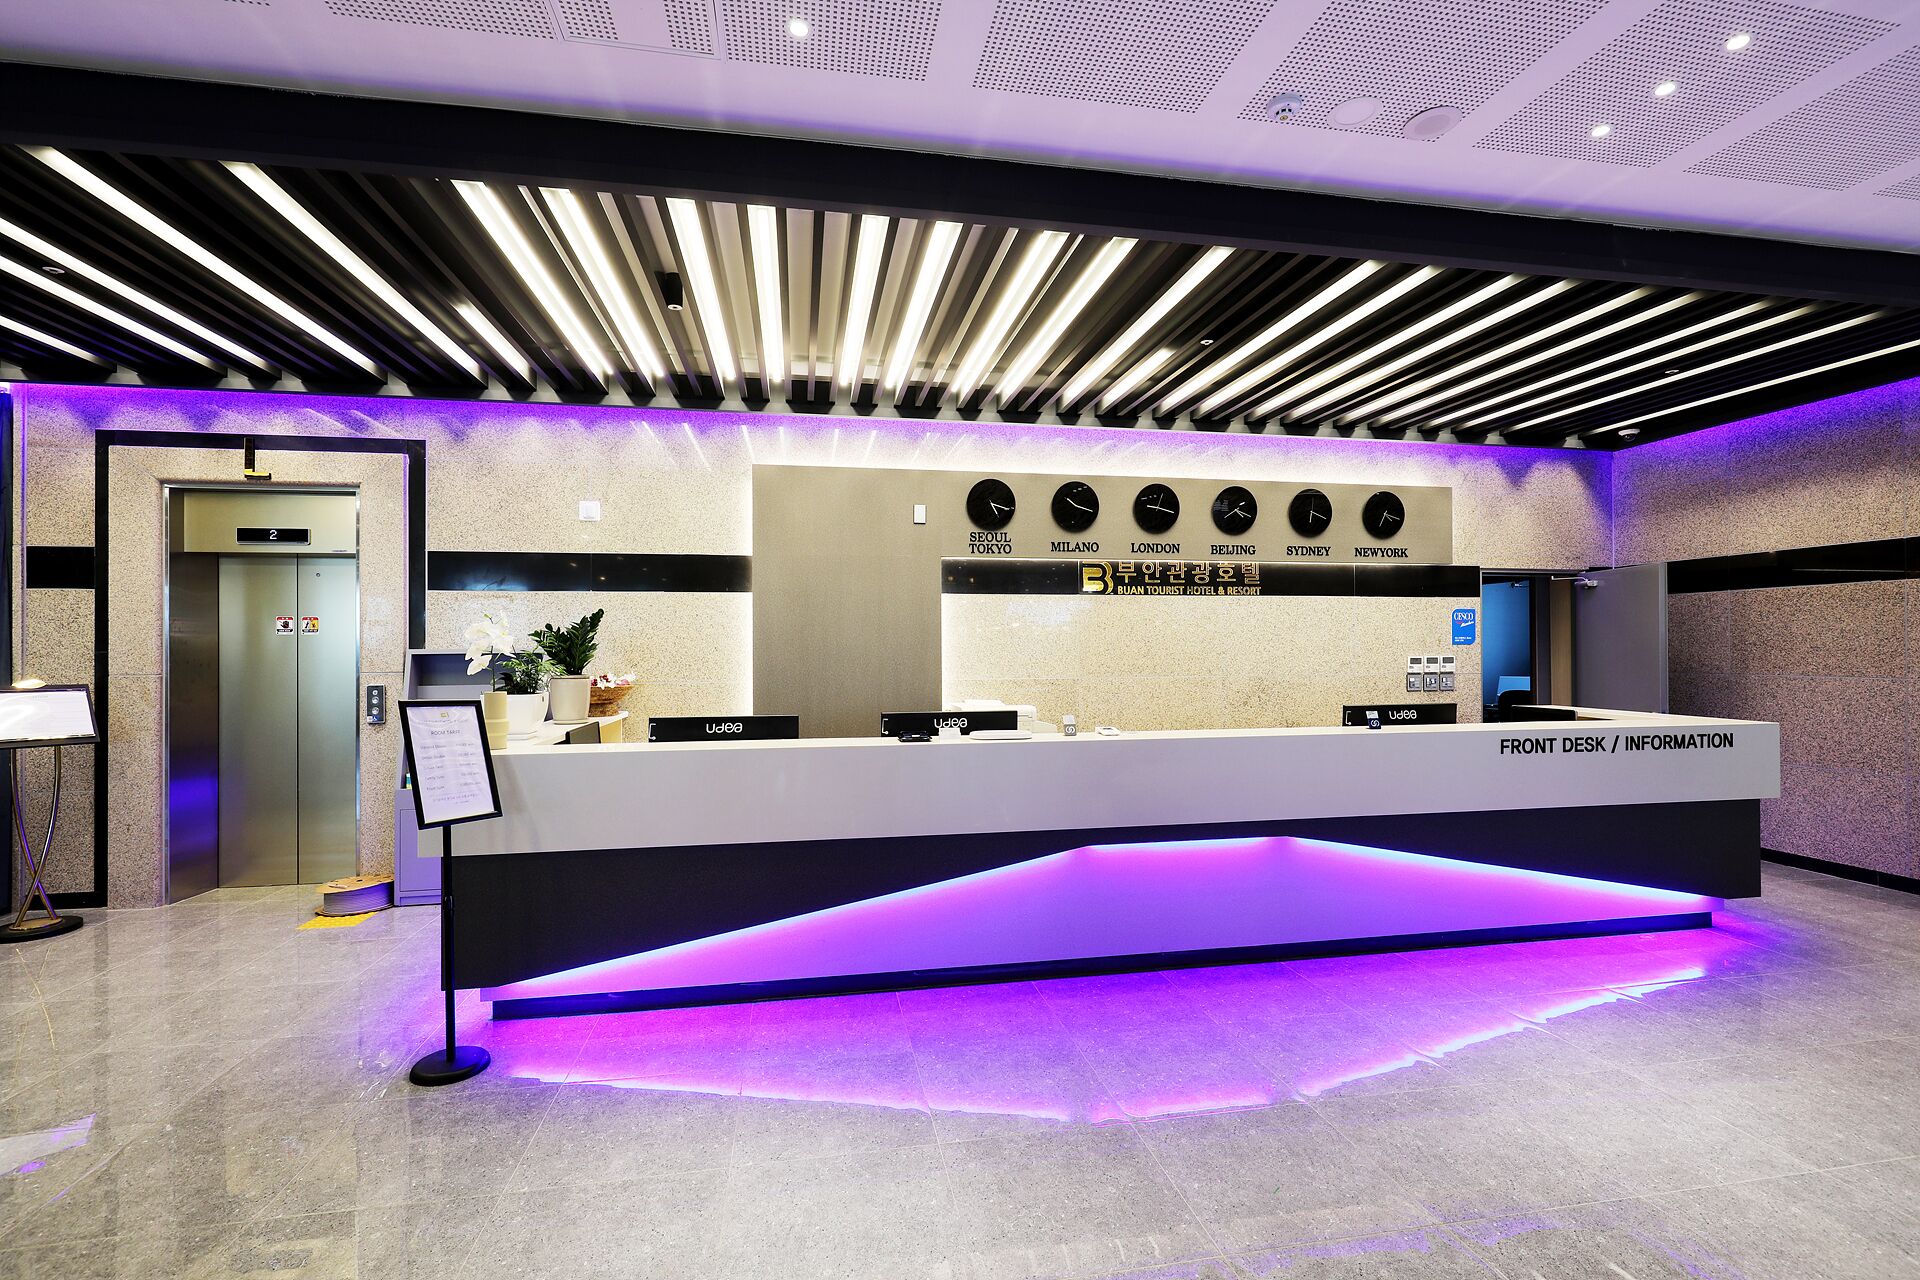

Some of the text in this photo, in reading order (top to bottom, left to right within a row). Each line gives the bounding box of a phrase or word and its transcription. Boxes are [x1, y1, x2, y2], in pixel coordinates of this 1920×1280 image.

[269, 529, 278, 540] 2
[969, 532, 1012, 543] SEOUL
[968, 543, 1012, 554] TOKYO
[1050, 541, 1100, 553] MILANO
[1131, 542, 1180, 554] LONDON
[1210, 544, 1257, 555] BEIJING
[1286, 545, 1331, 556] SYDNEY
[1354, 547, 1408, 558] NEWYORK
[1116, 561, 1261, 585] 부안관광호텔
[1117, 585, 1262, 595] BUAN TOURIST HOTEL & RESORT
[1388, 709, 1417, 720] udea
[706, 722, 743, 734] udea
[933, 717, 968, 729] udea
[1499, 733, 1734, 754] FRONT DESK / INFORMATION
